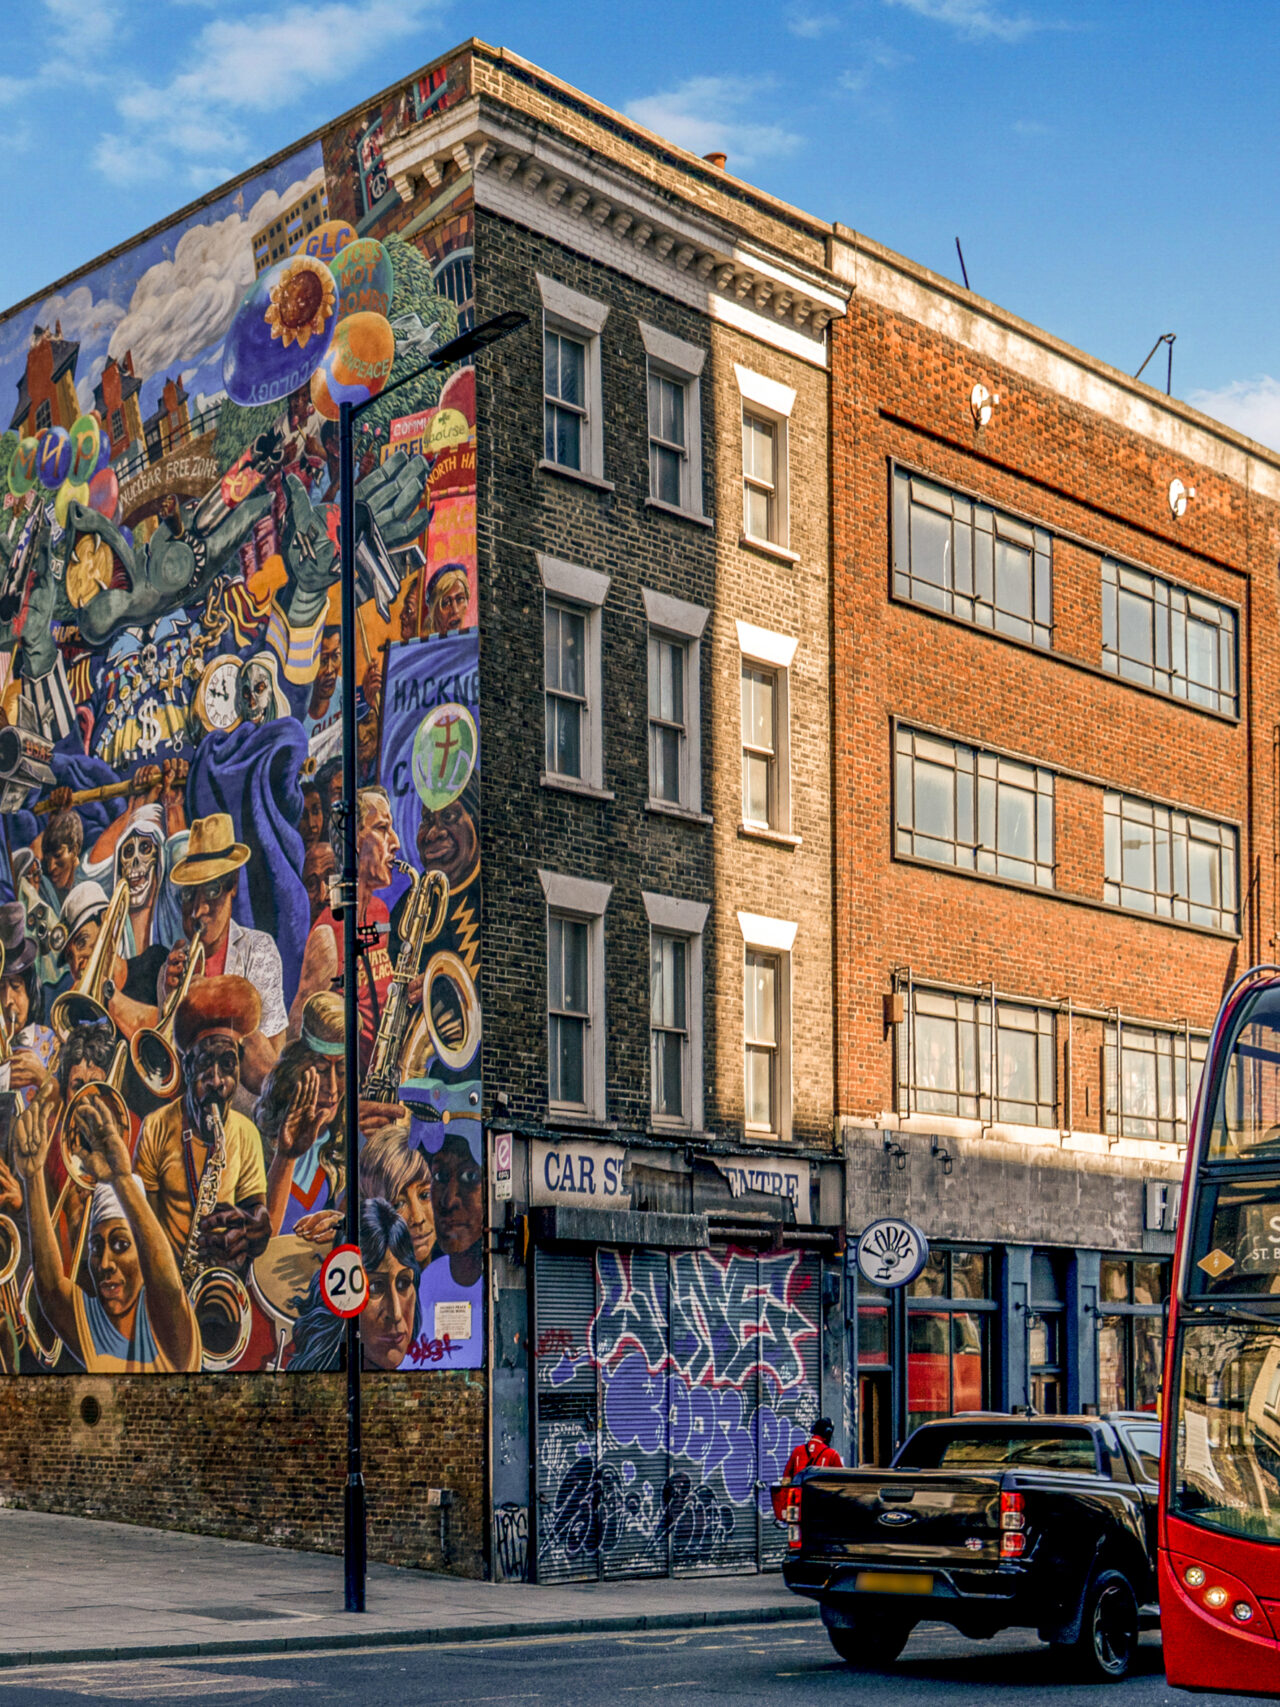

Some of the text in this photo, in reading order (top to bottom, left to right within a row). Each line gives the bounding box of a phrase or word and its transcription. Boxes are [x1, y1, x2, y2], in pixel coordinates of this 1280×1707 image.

[306, 227, 351, 257] GLC
[337, 241, 384, 270] JOBS
[341, 263, 377, 289] NOT
[119, 455, 220, 506] NUCLEAR FREE ZONE
[544, 1151, 596, 1195] CAR
[719, 1166, 800, 1209] ENTRE
[328, 1265, 365, 1297] 20
